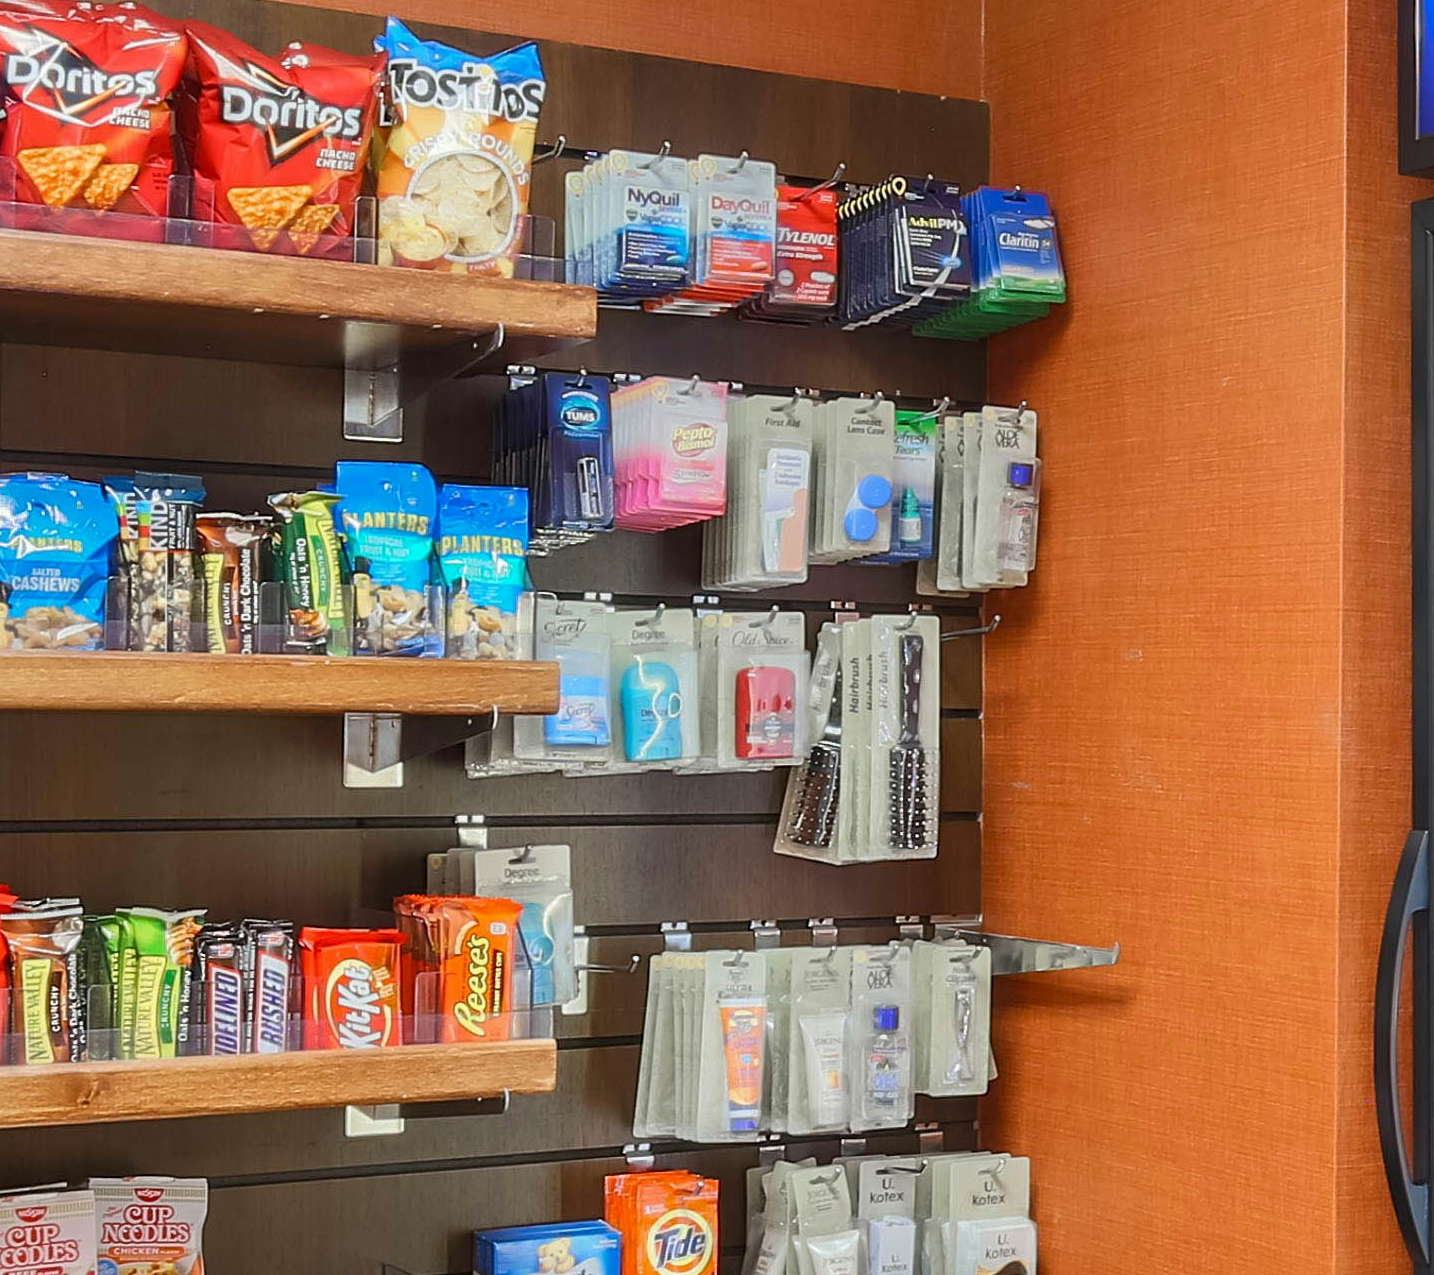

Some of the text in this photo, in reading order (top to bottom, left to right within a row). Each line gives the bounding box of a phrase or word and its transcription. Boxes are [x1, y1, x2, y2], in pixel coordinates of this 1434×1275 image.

[4, 52, 158, 97] Doritos
[389, 59, 546, 123] TOSTITOS
[221, 85, 362, 138] Doritos
[109, 114, 153, 131] CHEESE
[314, 155, 357, 171] CHEESE
[319, 147, 357, 162] NACHO
[627, 187, 681, 208] NyQuil
[711, 195, 770, 216] DayQuil
[777, 227, 836, 248] TYLENOL
[999, 233, 1041, 250] Claritin
[566, 410, 596, 422] TUMS
[672, 425, 714, 442] Pepto
[847, 426, 886, 437] Lens Case
[896, 445, 922, 456] Tears
[150, 496, 168, 551] KIND
[442, 535, 524, 557] PLANTERS
[31, 567, 61, 577] SALTED
[12, 575, 80, 593] CASHEWS
[848, 657, 860, 714] Hairbrush
[504, 867, 540, 879] Degree
[453, 934, 489, 1037] Reese's
[50, 985, 61, 1033] CRUNCHY
[338, 965, 382, 1049] KitKat
[869, 1190, 905, 1206] kotex
[972, 1193, 1007, 1207] kotex
[123, 1204, 174, 1225] CUP
[5, 1223, 61, 1248] CUP
[100, 1222, 192, 1245] NOODLES
[112, 1247, 160, 1256] CHICKEN
[653, 1227, 707, 1271] Tide
[985, 1245, 1018, 1260] kotex
[881, 1262, 910, 1274] kotex
